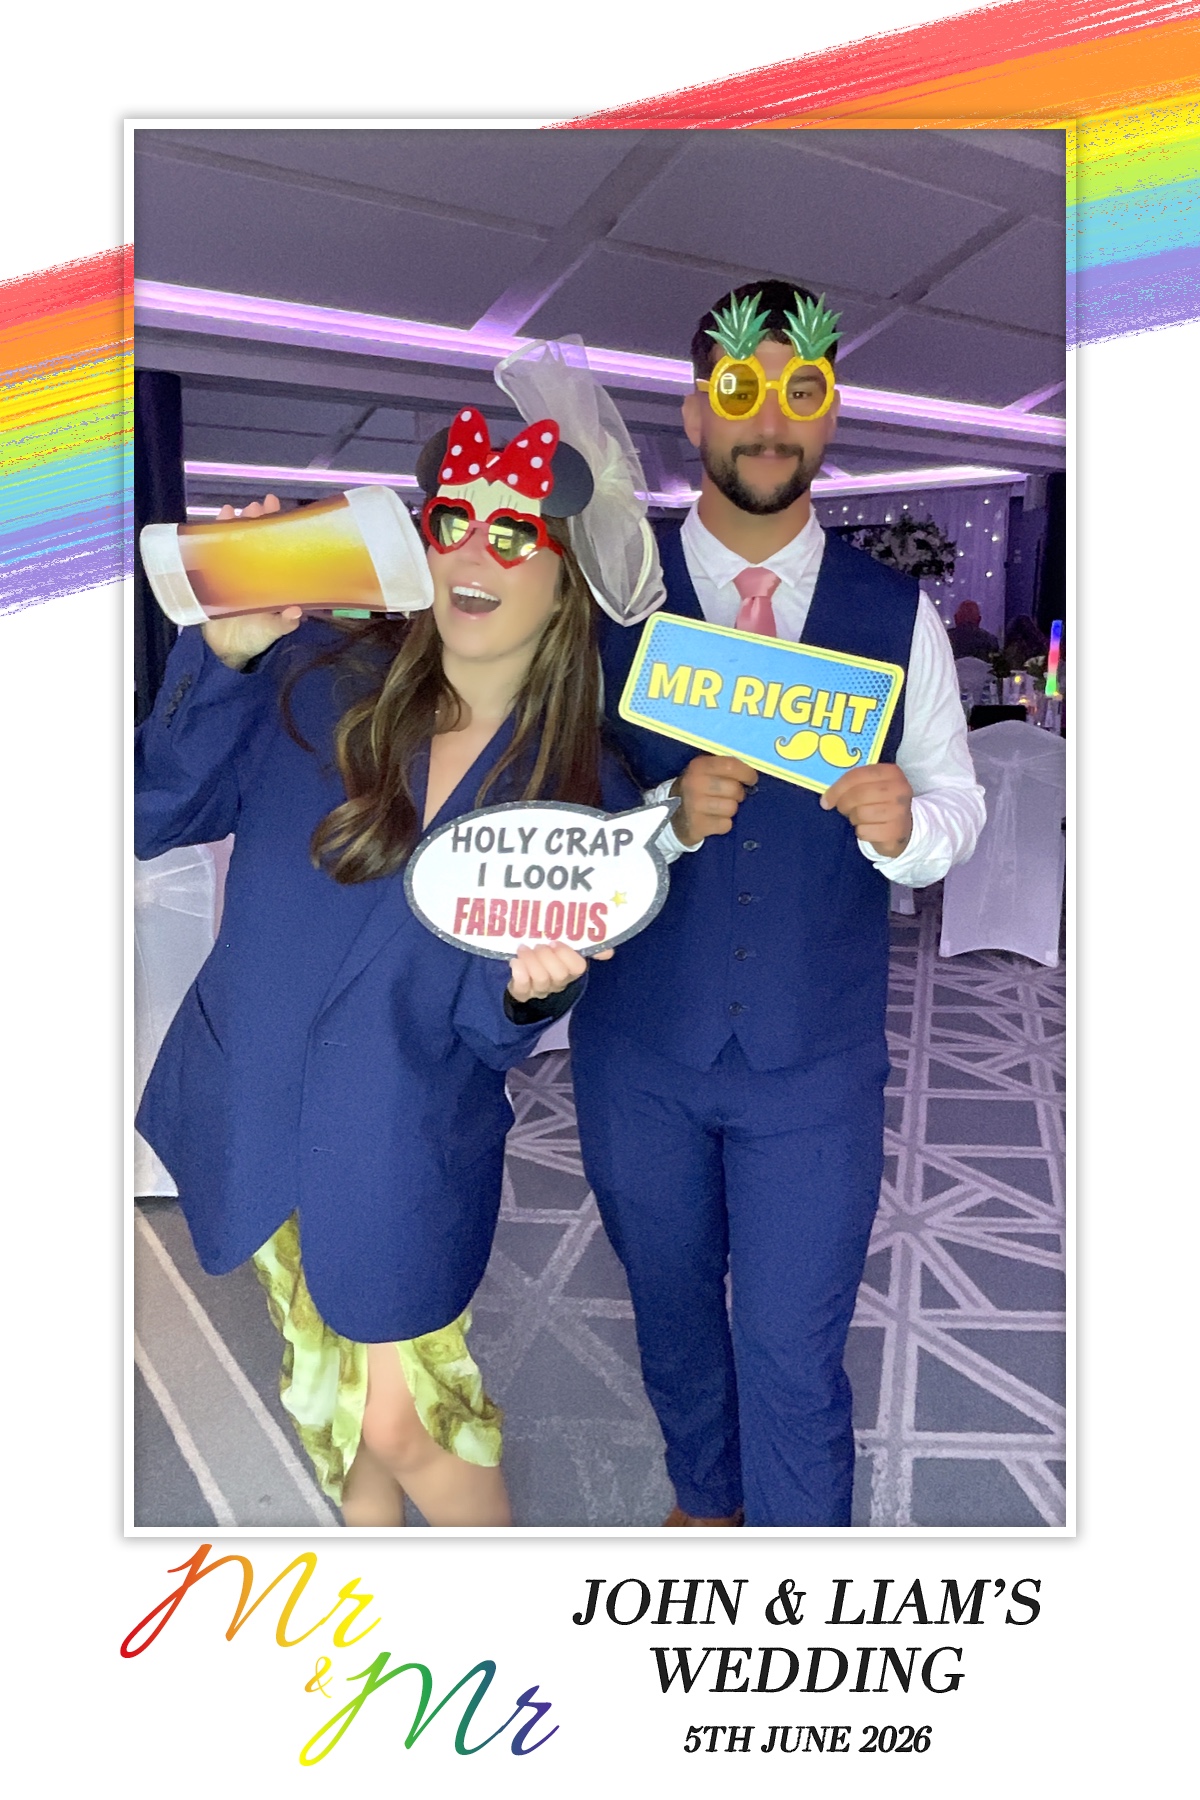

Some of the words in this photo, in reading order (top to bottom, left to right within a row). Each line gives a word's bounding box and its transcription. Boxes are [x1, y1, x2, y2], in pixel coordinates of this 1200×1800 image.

[648, 661, 724, 709] MR
[730, 675, 878, 734] RIGHT
[451, 825, 538, 854] HOLY
[545, 827, 634, 857] CRAP
[477, 862, 488, 887] I
[504, 864, 595, 892] LOOK
[453, 897, 608, 942] FABULOUS
